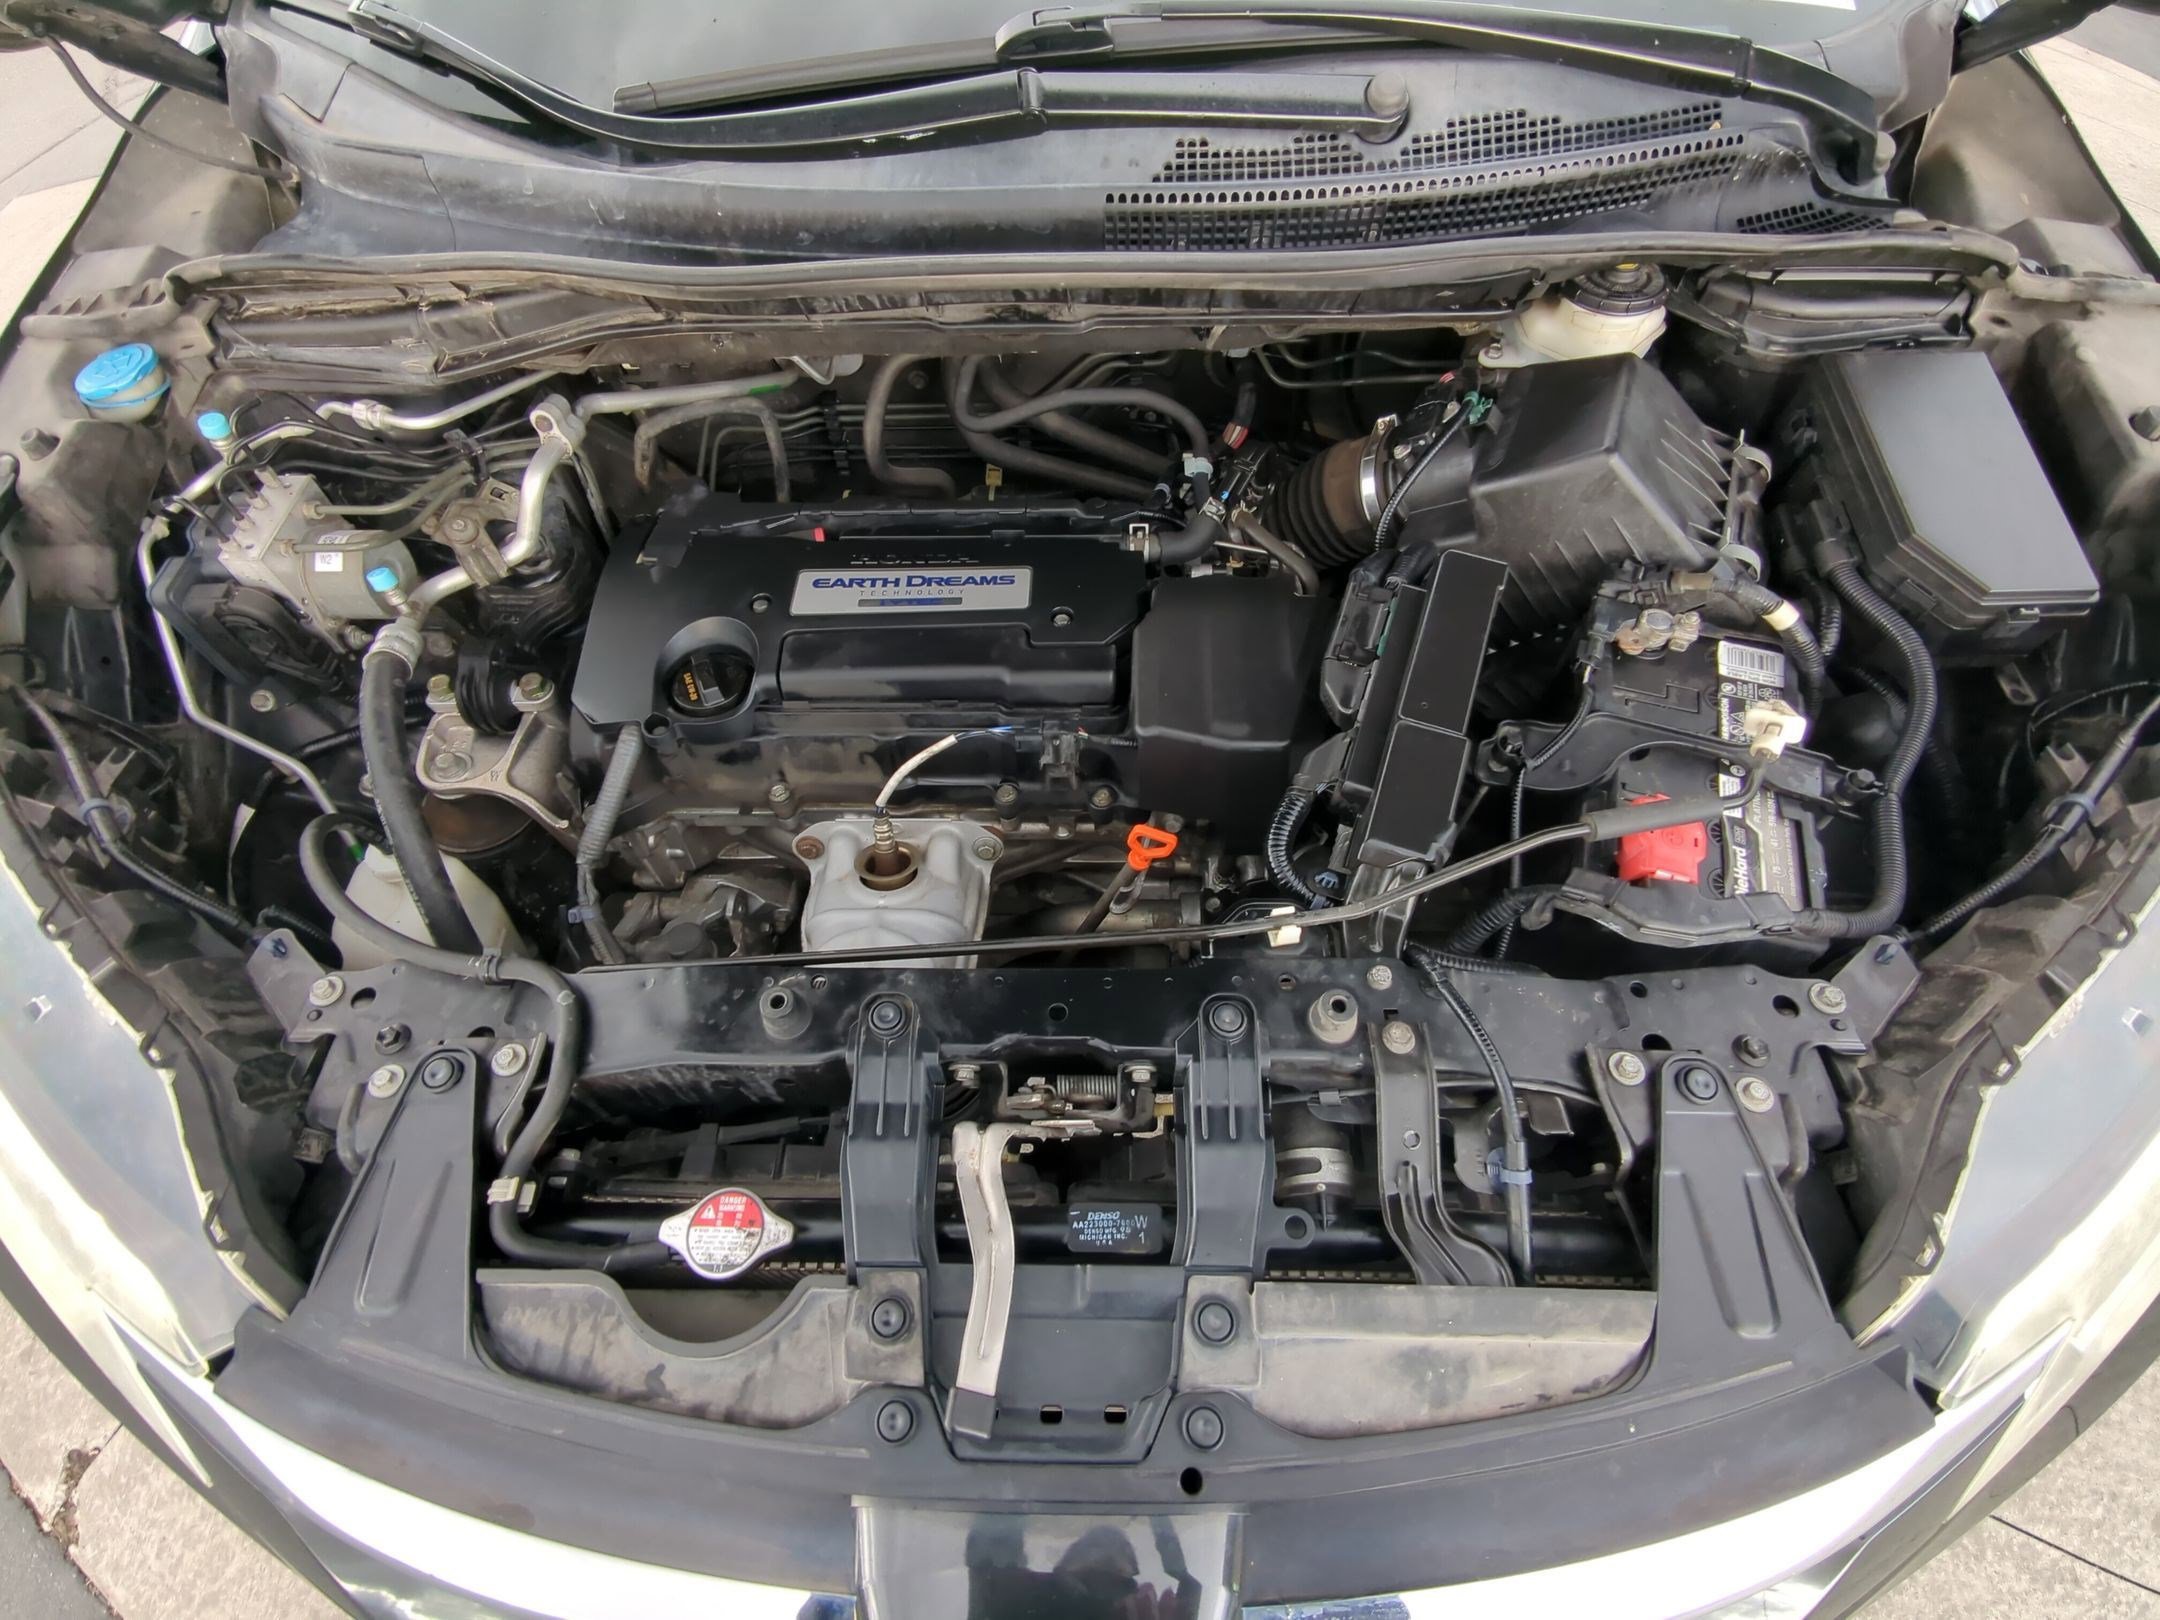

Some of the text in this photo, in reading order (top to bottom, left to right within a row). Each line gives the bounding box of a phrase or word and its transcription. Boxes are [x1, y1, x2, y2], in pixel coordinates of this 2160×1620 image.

[811, 575, 1016, 589] EARTH DREAMS
[860, 588, 965, 597] TECHNOLOGY
[683, 672, 693, 685] SAE
[1087, 1211, 1121, 1221] DENSO
[1134, 1214, 1148, 1230] W
